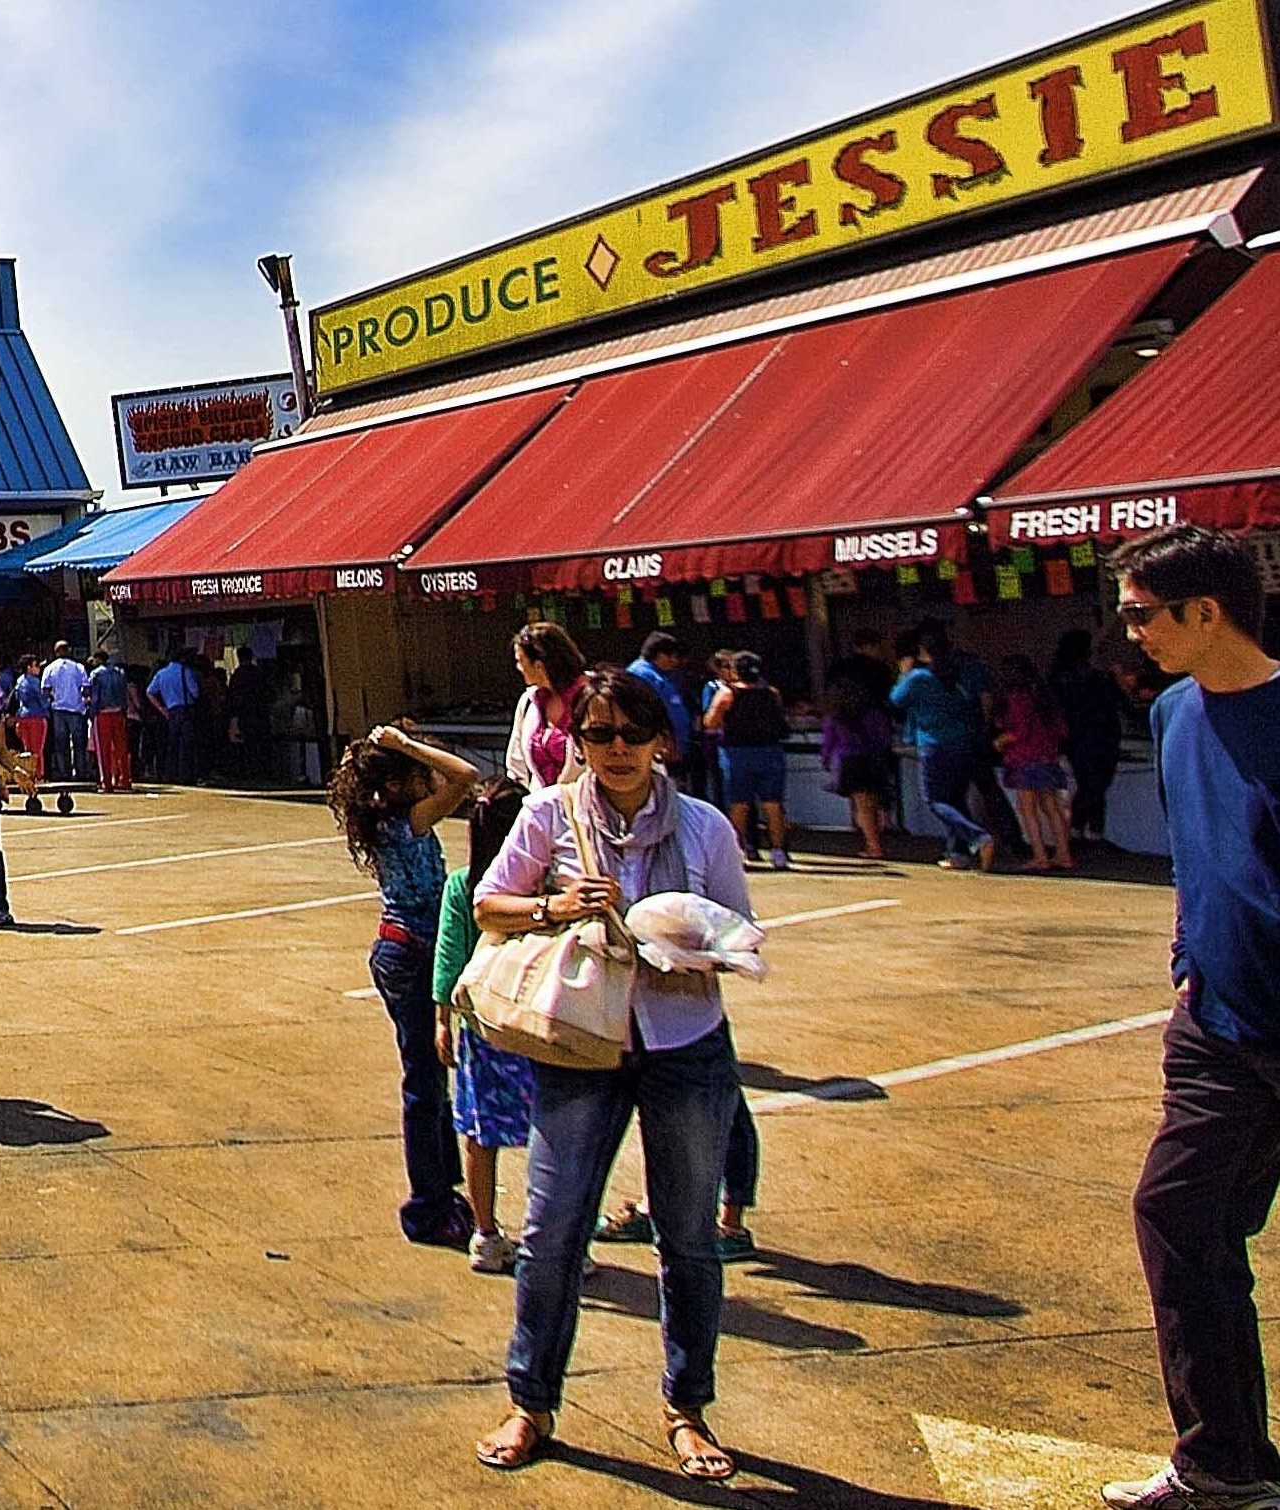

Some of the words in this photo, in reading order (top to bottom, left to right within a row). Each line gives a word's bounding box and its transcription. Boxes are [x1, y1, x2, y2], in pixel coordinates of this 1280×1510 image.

[330, 257, 560, 364] PRODUCE
[644, 23, 1219, 278] JESSIE
[154, 453, 200, 472] RAW
[1009, 505, 1100, 540] FRESH
[1110, 495, 1177, 531] FISH
[834, 529, 939, 563] MUSSELS
[336, 567, 383, 589] MELONS
[603, 552, 663, 580] CLAMS
[191, 578, 219, 595] FRESH
[221, 575, 262, 594] PRODUCE
[420, 571, 477, 592] OYSTERS
